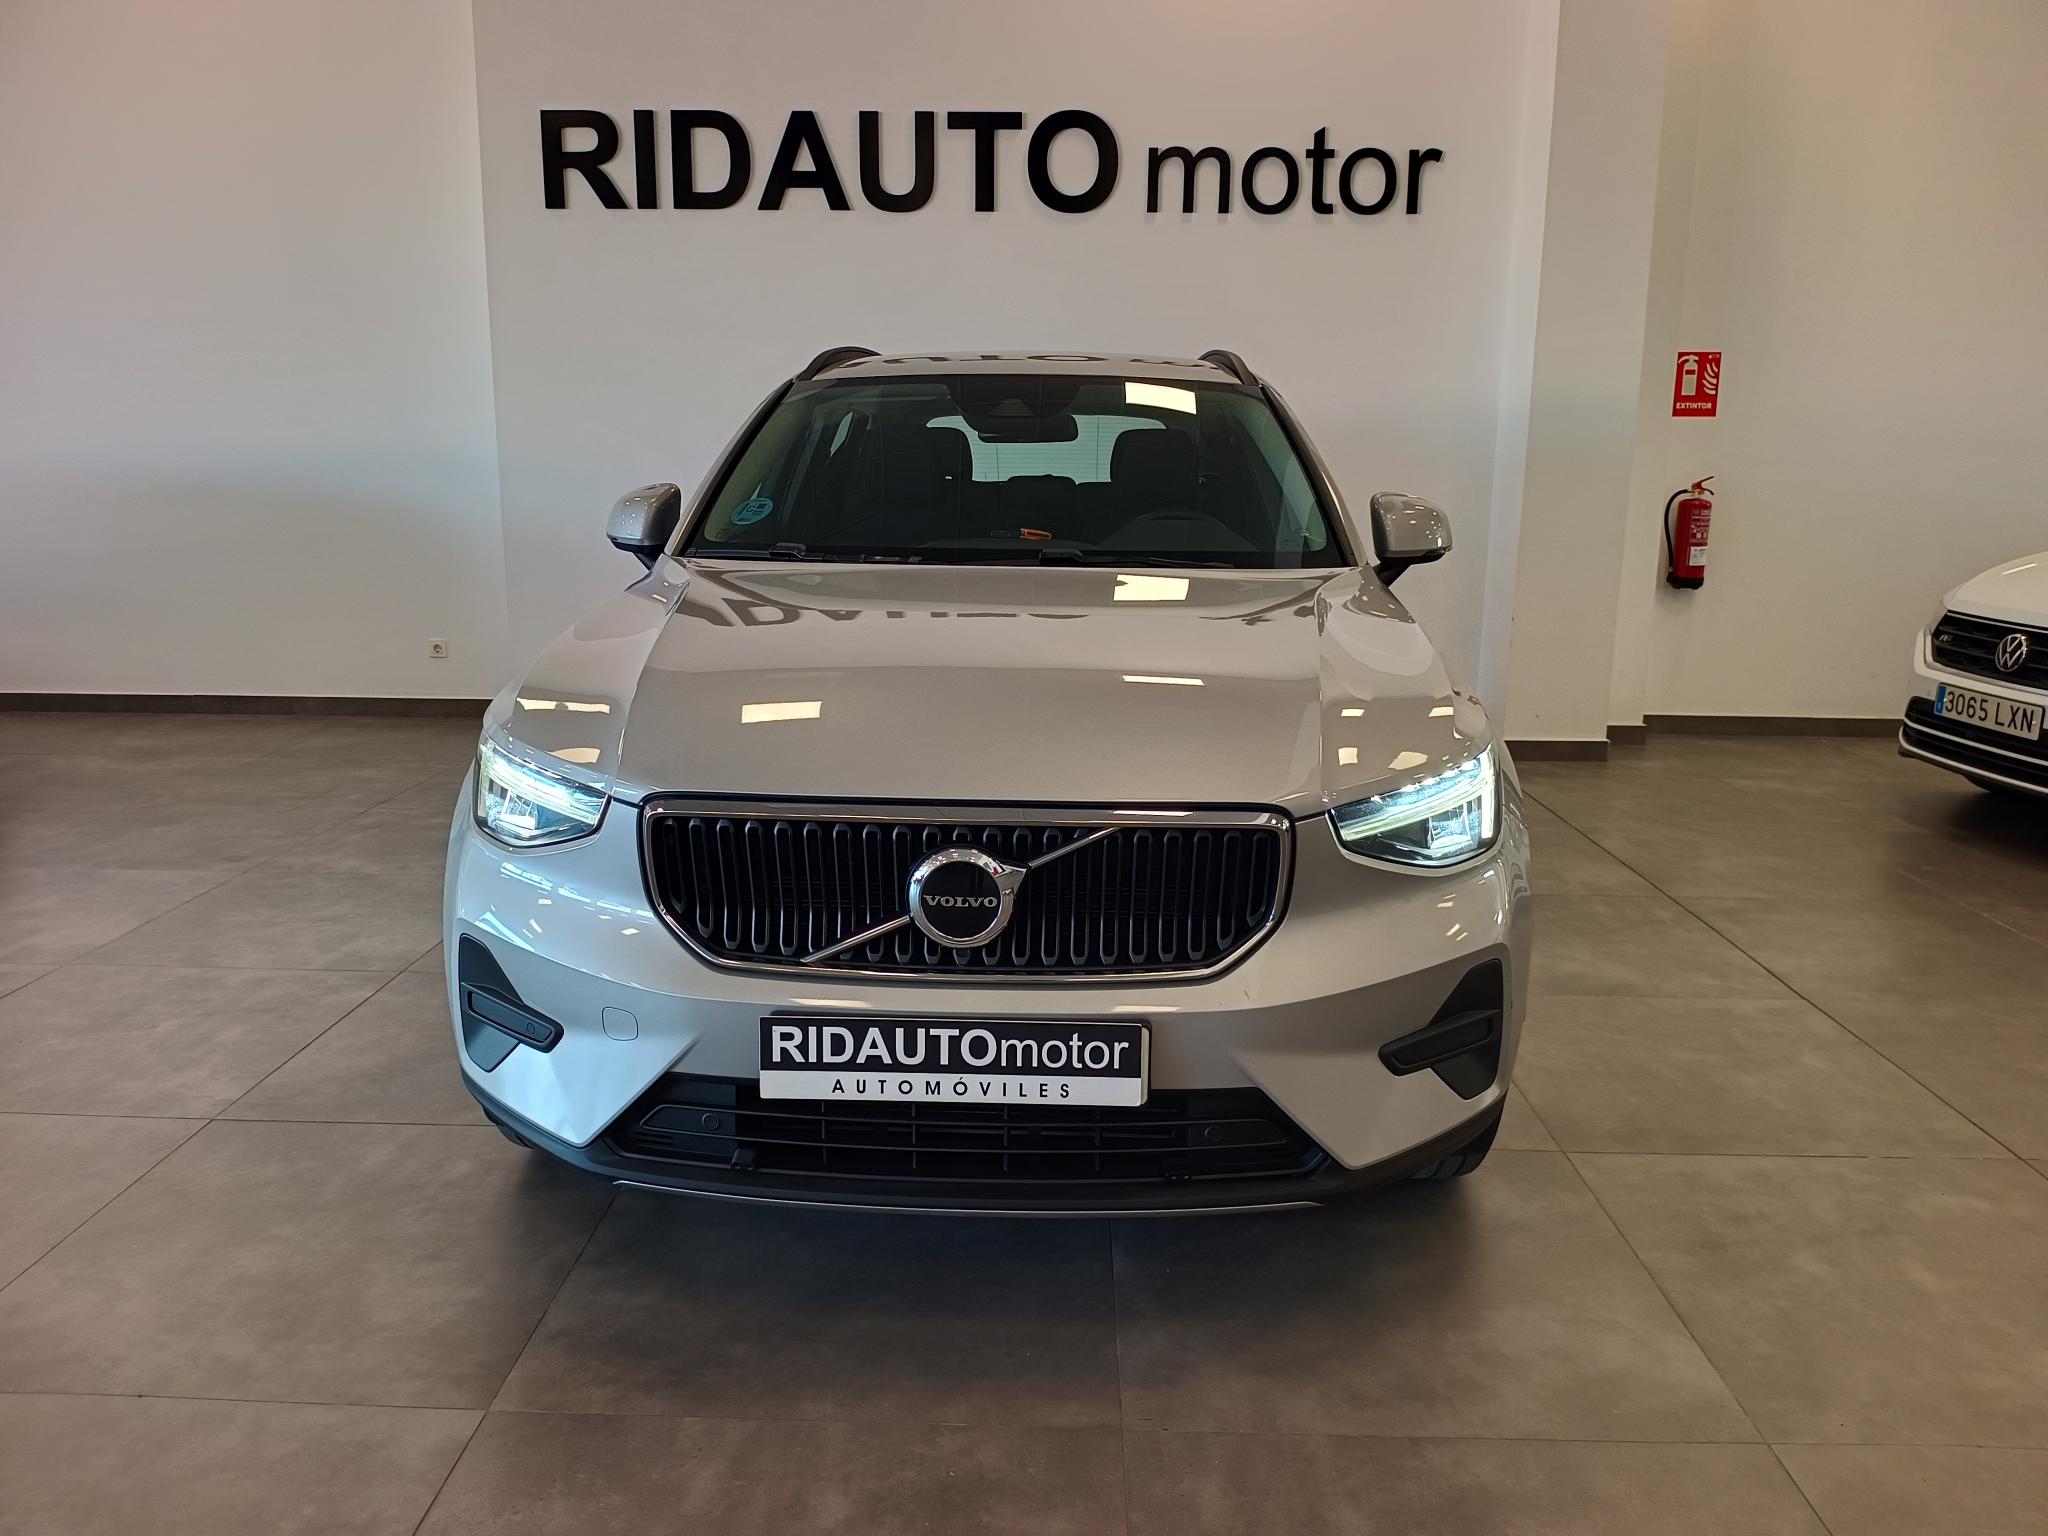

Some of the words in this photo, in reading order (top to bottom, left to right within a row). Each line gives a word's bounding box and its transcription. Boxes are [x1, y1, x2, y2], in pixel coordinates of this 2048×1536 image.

[540, 109, 1119, 213] RIDAUTO
[1147, 127, 1443, 215] motor
[1945, 691, 1988, 722] 3065
[1995, 702, 2034, 733] LXN
[922, 894, 998, 908] VOLVO
[831, 1076, 1071, 1099] AUTOMÓVILES
